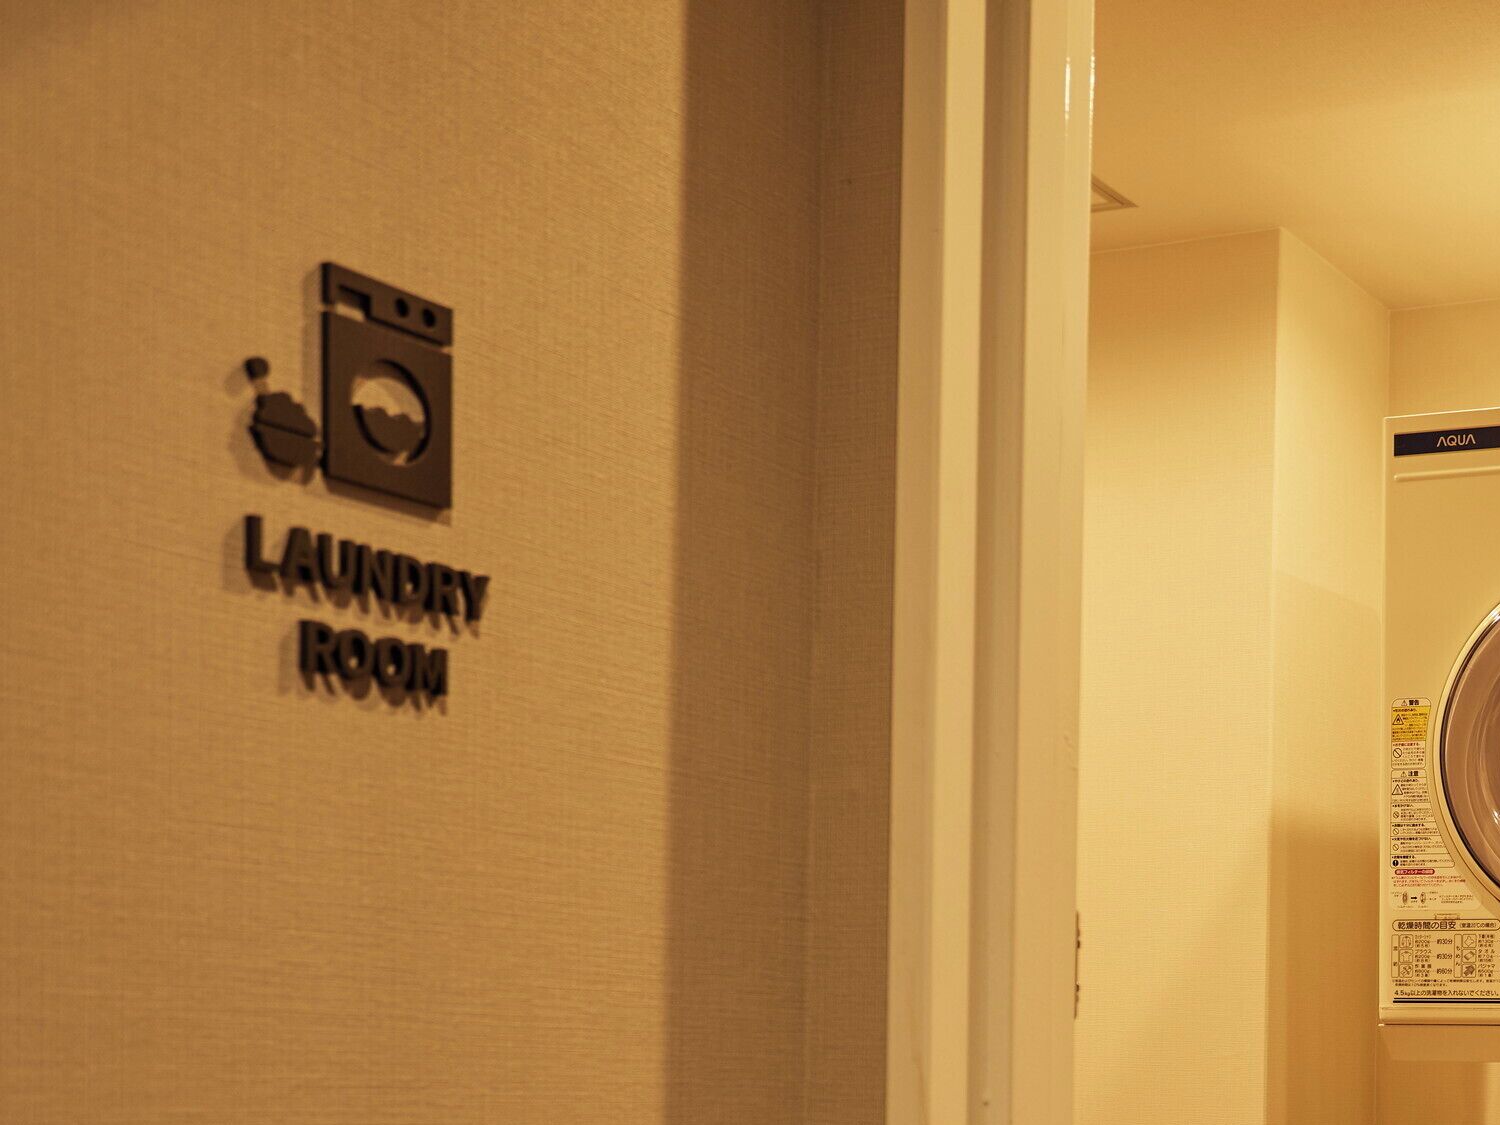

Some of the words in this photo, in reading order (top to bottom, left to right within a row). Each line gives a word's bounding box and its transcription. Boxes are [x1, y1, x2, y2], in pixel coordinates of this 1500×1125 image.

[1436, 433, 1476, 447] AQUA
[243, 514, 491, 626] LAUNDRY
[298, 619, 449, 699] ROOM
